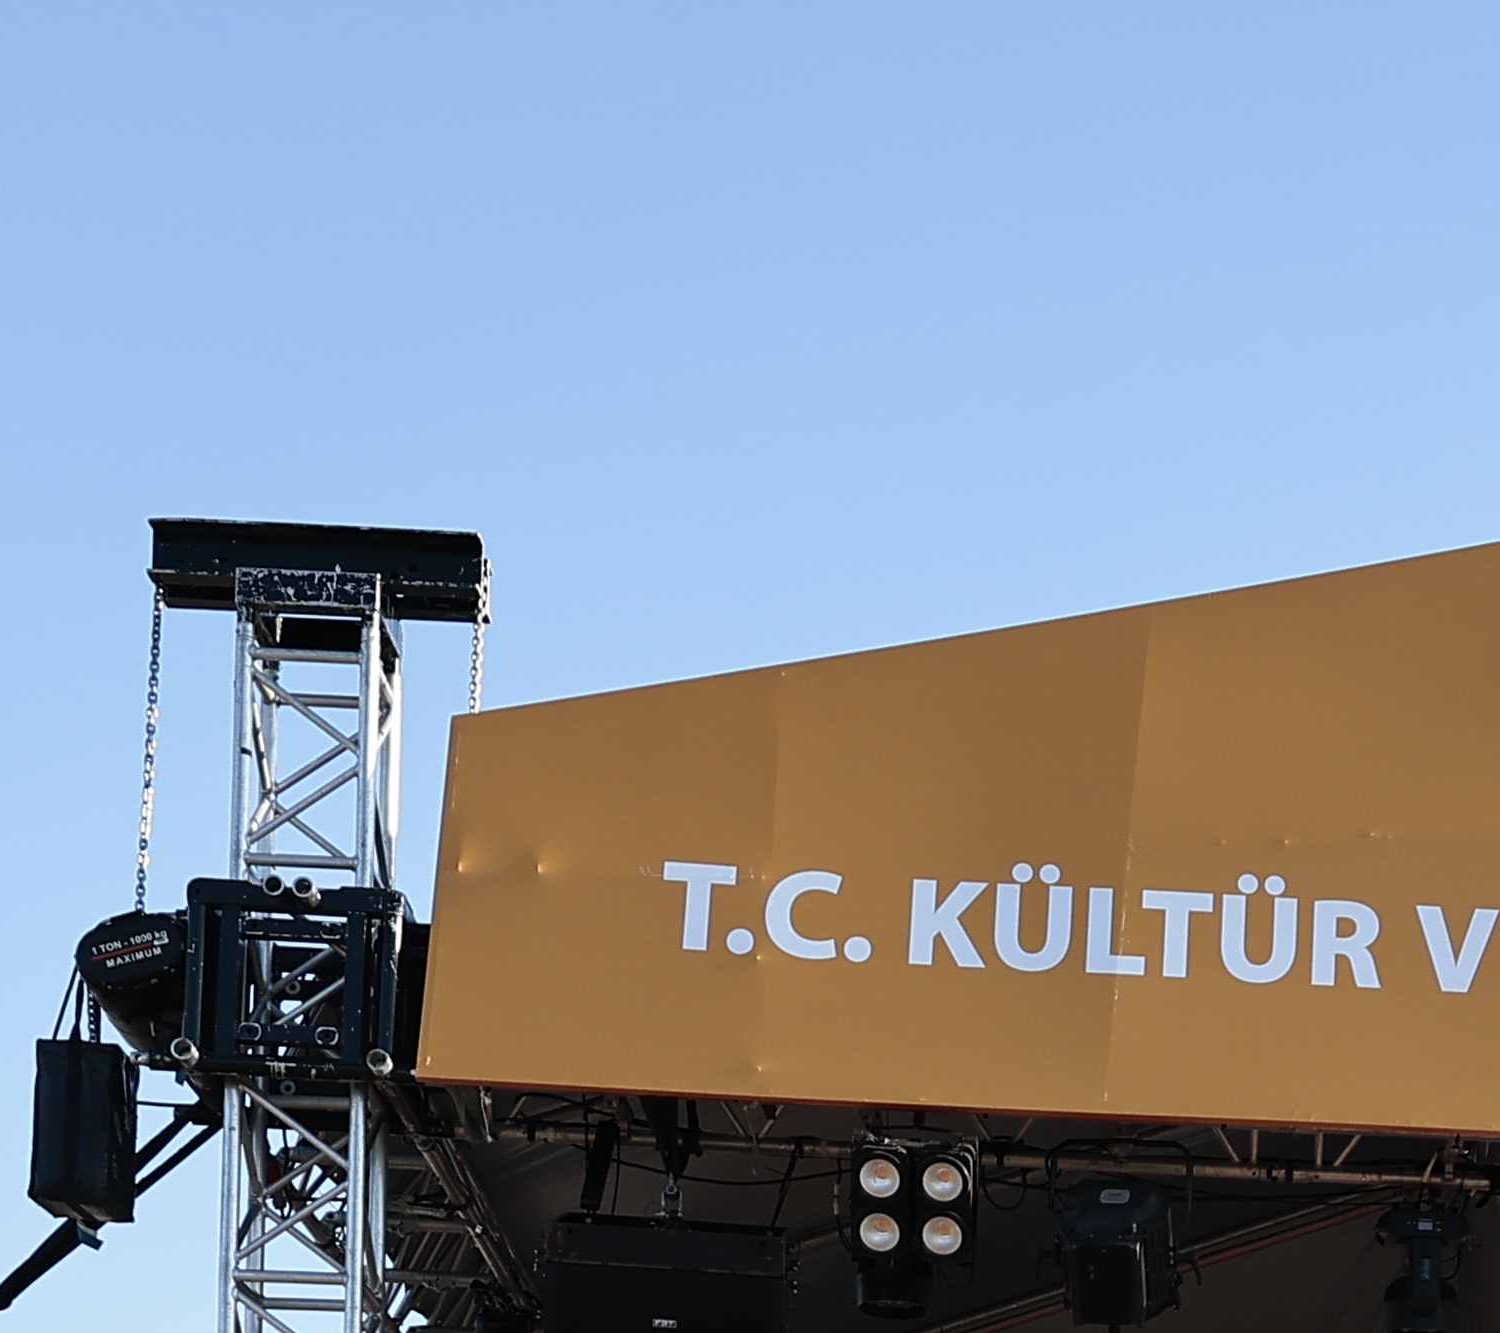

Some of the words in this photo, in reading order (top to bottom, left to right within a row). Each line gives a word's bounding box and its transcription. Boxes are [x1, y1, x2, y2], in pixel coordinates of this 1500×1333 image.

[662, 861, 873, 964] T.C.
[907, 861, 1382, 990] KÜLTÜR
[99, 940, 121, 953] TON
[105, 946, 163, 968] MAXIMUM
